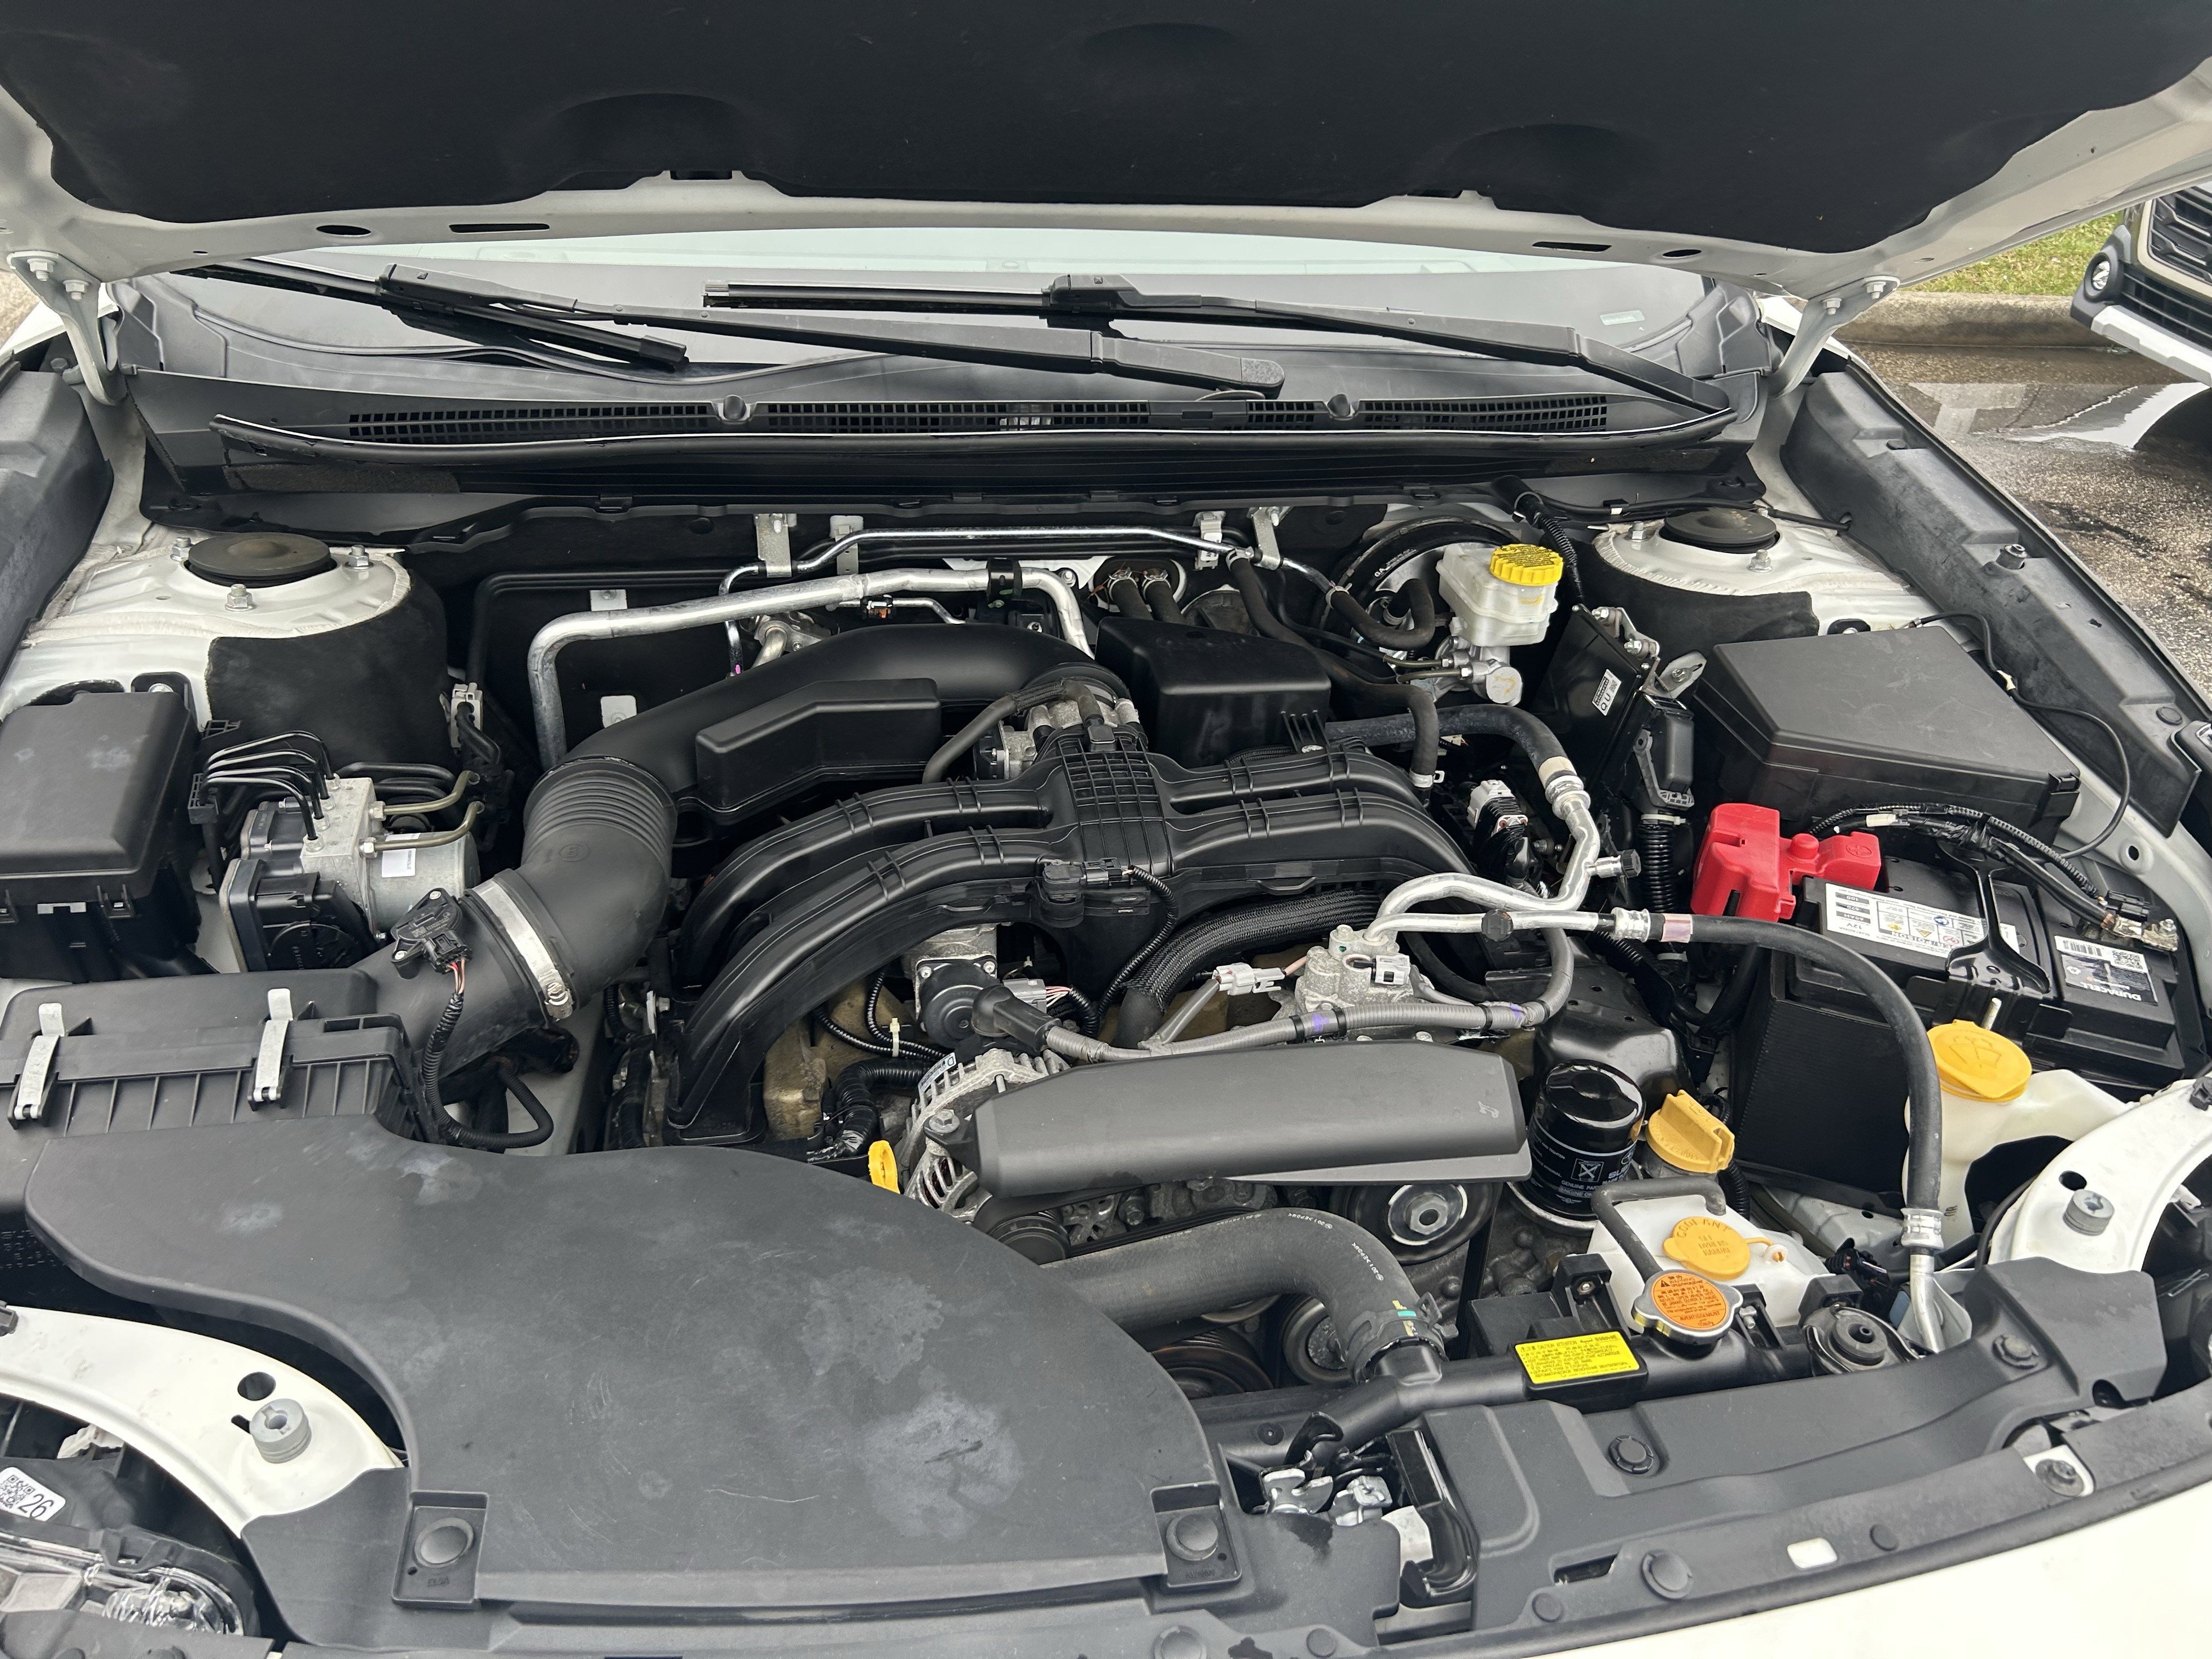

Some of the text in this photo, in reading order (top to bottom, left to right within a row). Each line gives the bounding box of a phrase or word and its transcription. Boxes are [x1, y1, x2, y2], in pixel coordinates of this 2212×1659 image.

[1561, 1180, 1585, 1189] GENUINE
[1560, 1188, 1583, 1197] ENGINE
[18, 1493, 55, 1519] 26
